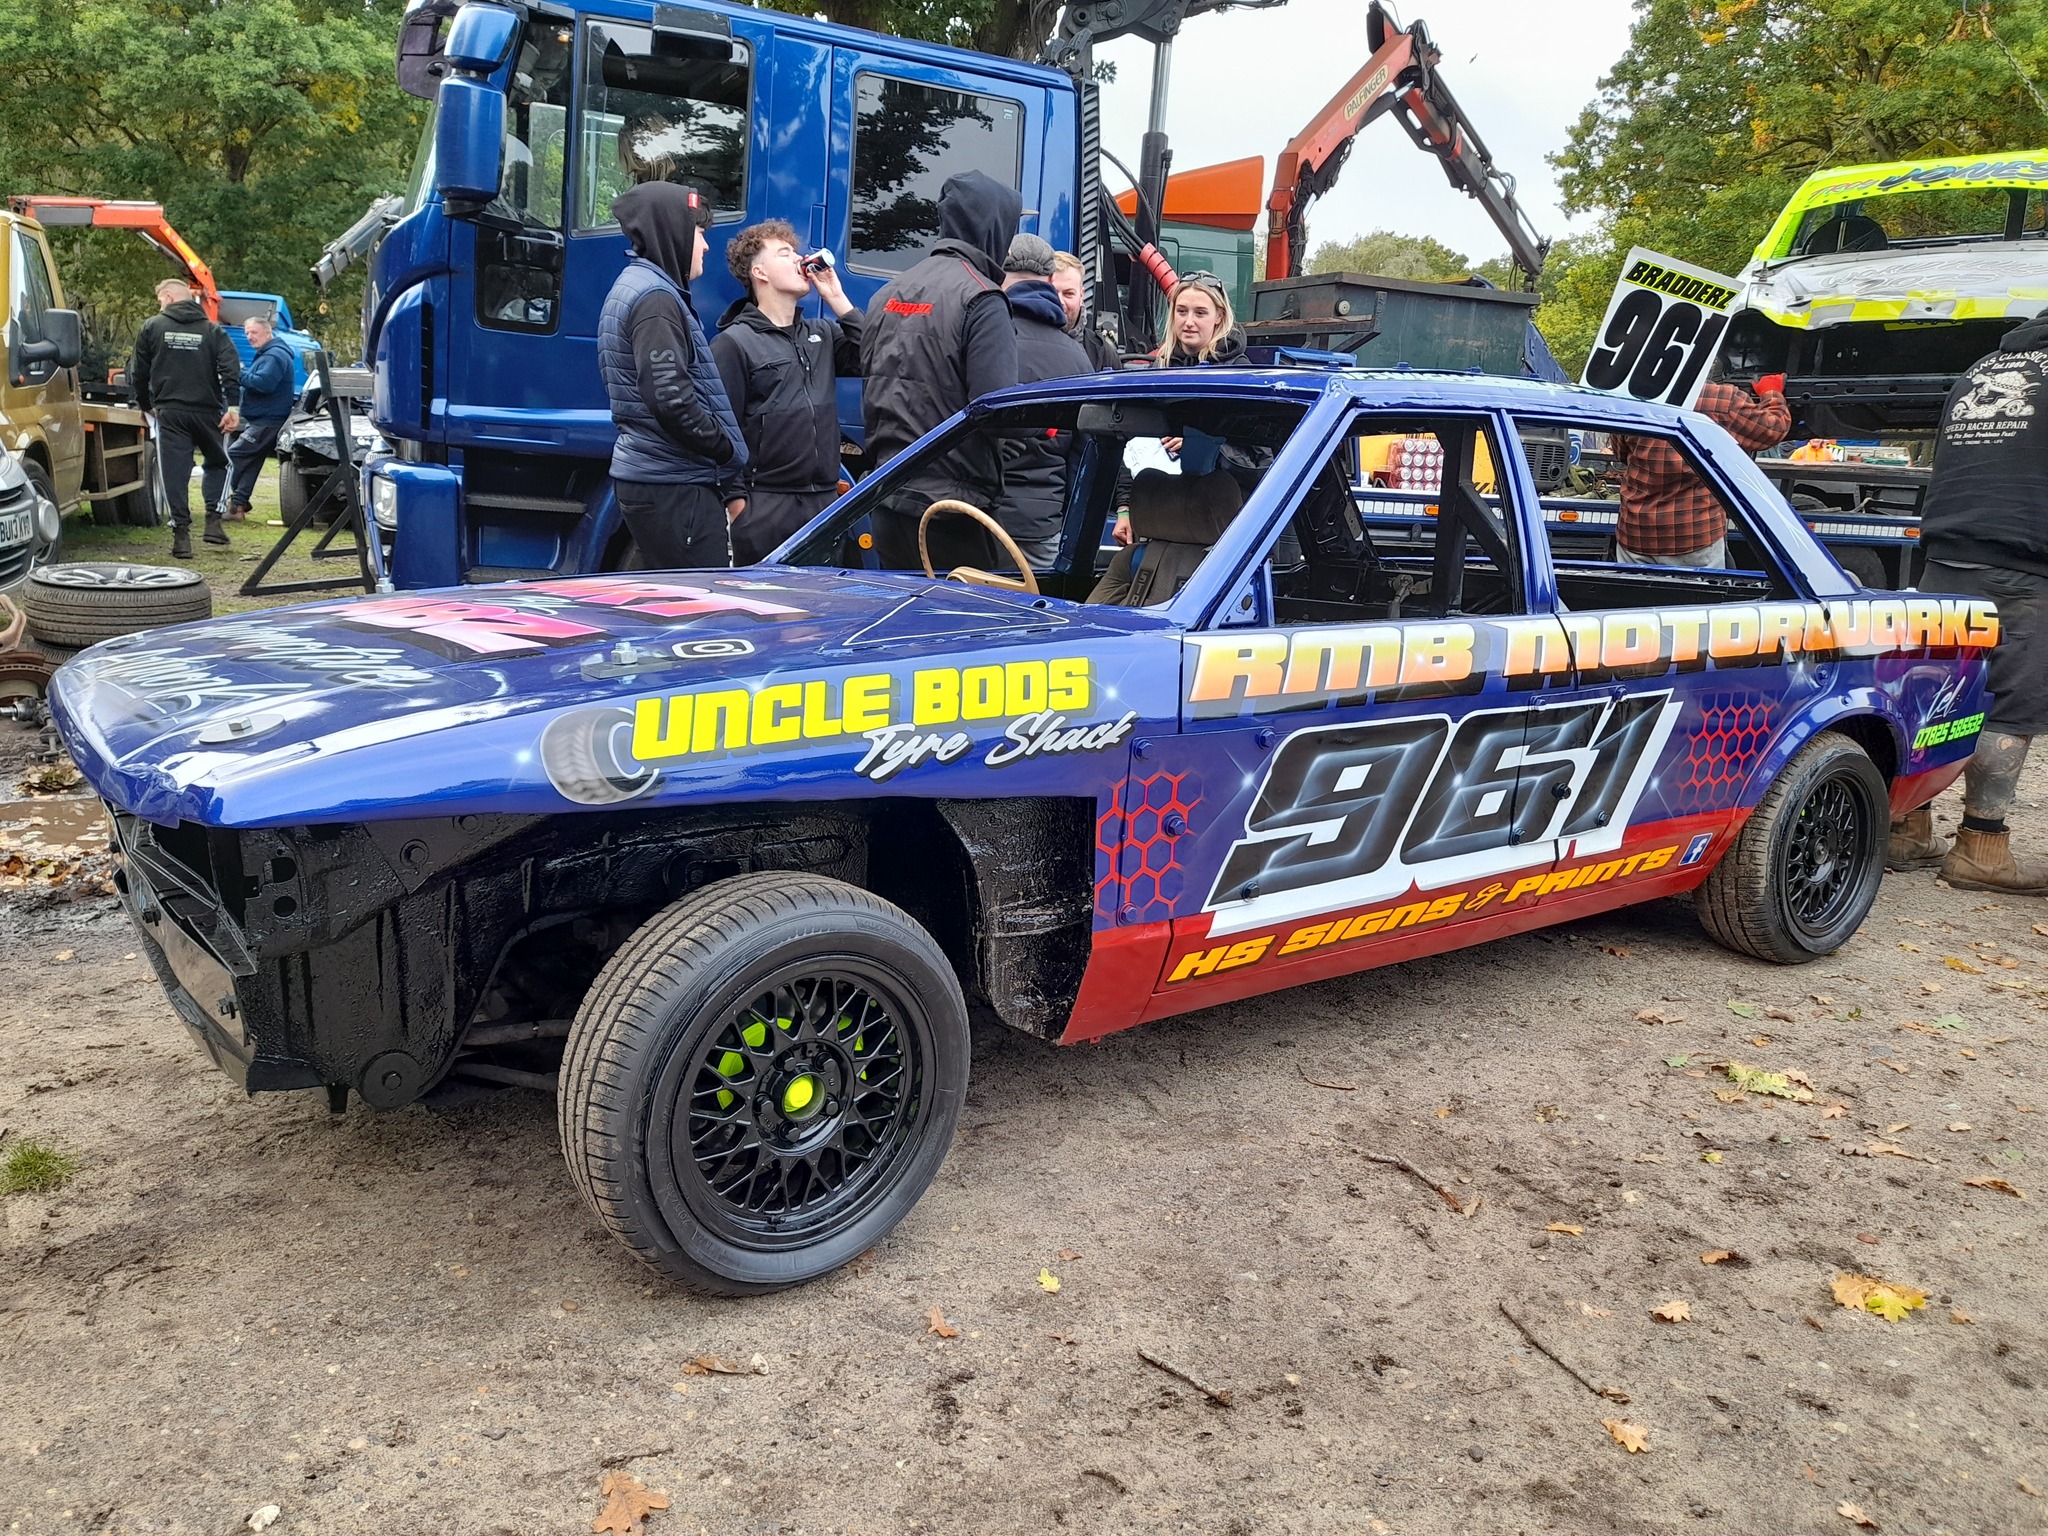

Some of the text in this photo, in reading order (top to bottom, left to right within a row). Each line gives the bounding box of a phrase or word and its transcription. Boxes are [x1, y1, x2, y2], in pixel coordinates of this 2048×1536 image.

[1346, 67, 1387, 118] PALFINGER
[1623, 259, 1739, 312] BRADDERZ
[1585, 289, 1730, 407] 961
[1966, 357, 1997, 379] VANS
[1999, 351, 2047, 363] CLASSIC
[1944, 420, 2029, 434] SPEED RACER REPAIR
[1166, 599, 2001, 703] RMB MOTORWORKS
[631, 657, 1091, 761] UNCLE BODS
[853, 709, 1139, 779] Tyre Shack
[1911, 721, 1953, 750] 07825
[1201, 688, 1683, 938] 961
[1166, 845, 1681, 984] HS SIGNS & PRINTS
